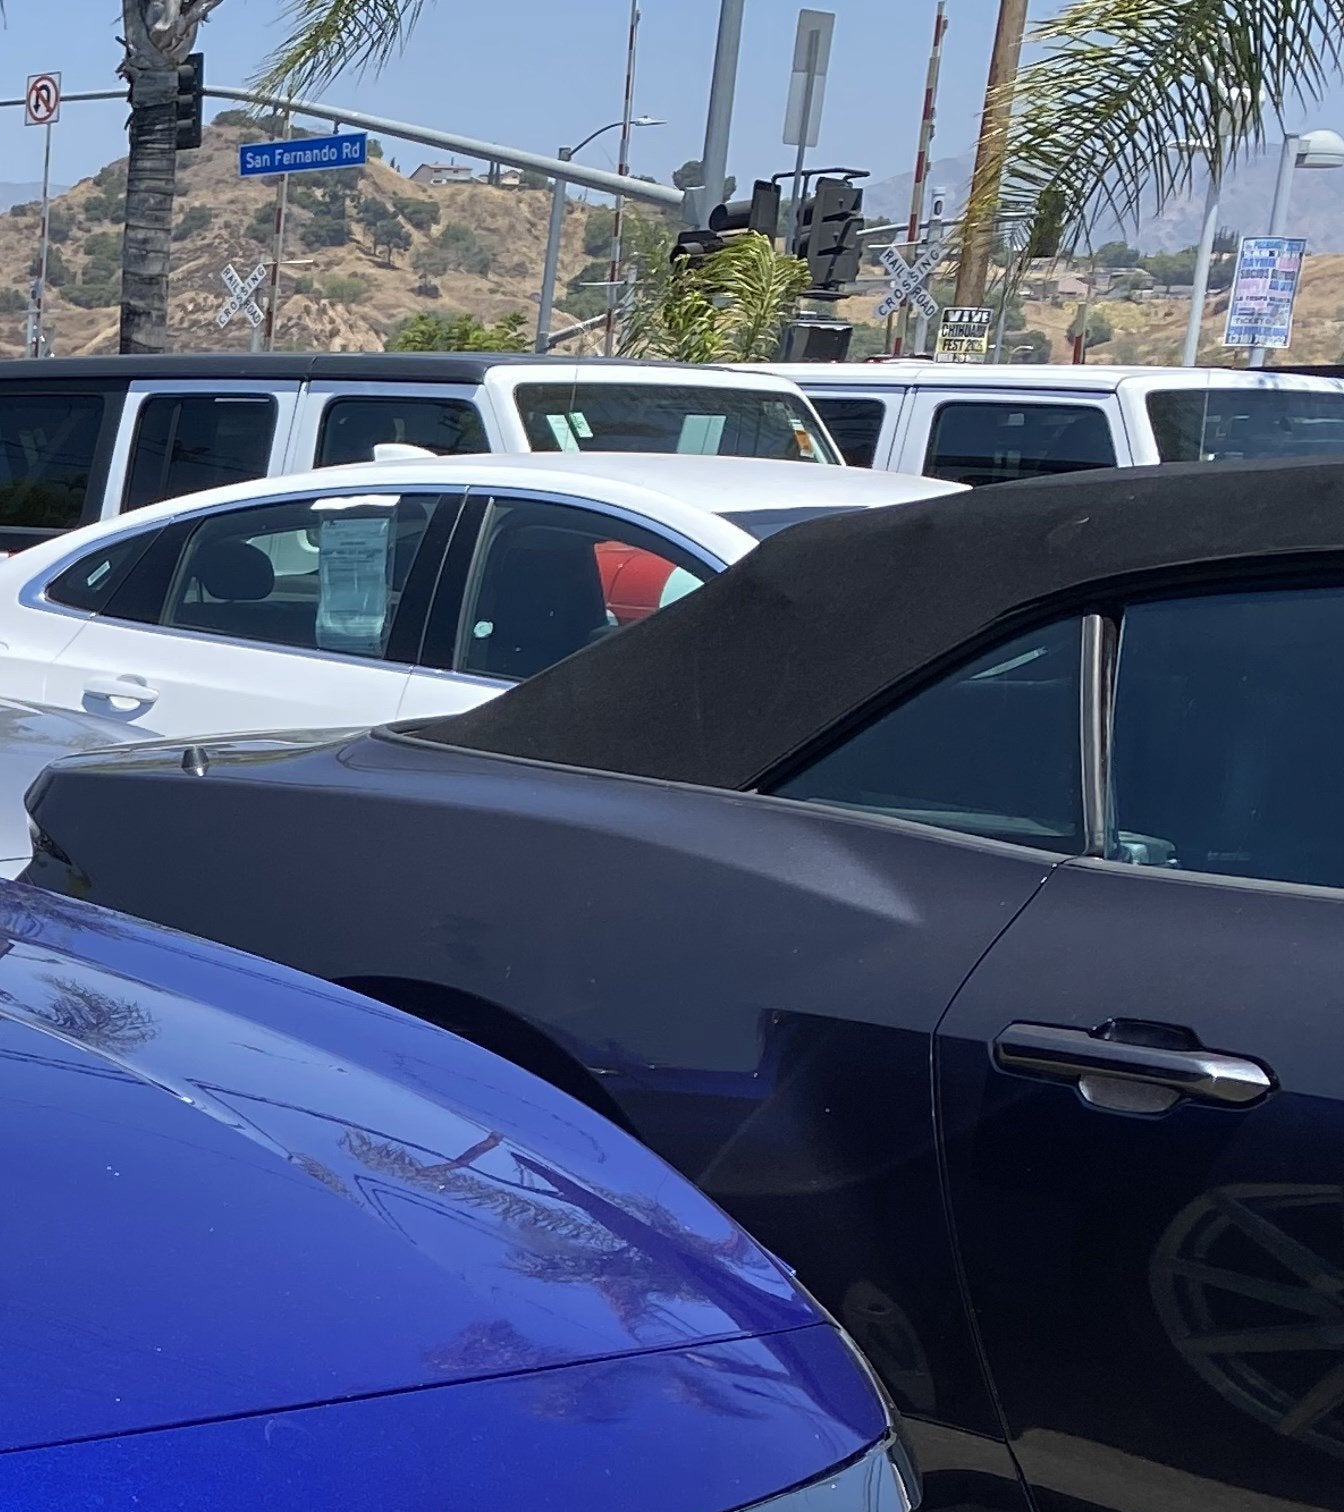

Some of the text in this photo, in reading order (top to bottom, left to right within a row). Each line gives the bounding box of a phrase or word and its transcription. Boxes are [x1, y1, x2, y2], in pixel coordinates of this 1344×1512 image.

[246, 142, 360, 169] San Fernando Rd
[878, 249, 939, 316] CROSSING
[942, 339, 965, 351] FEST
